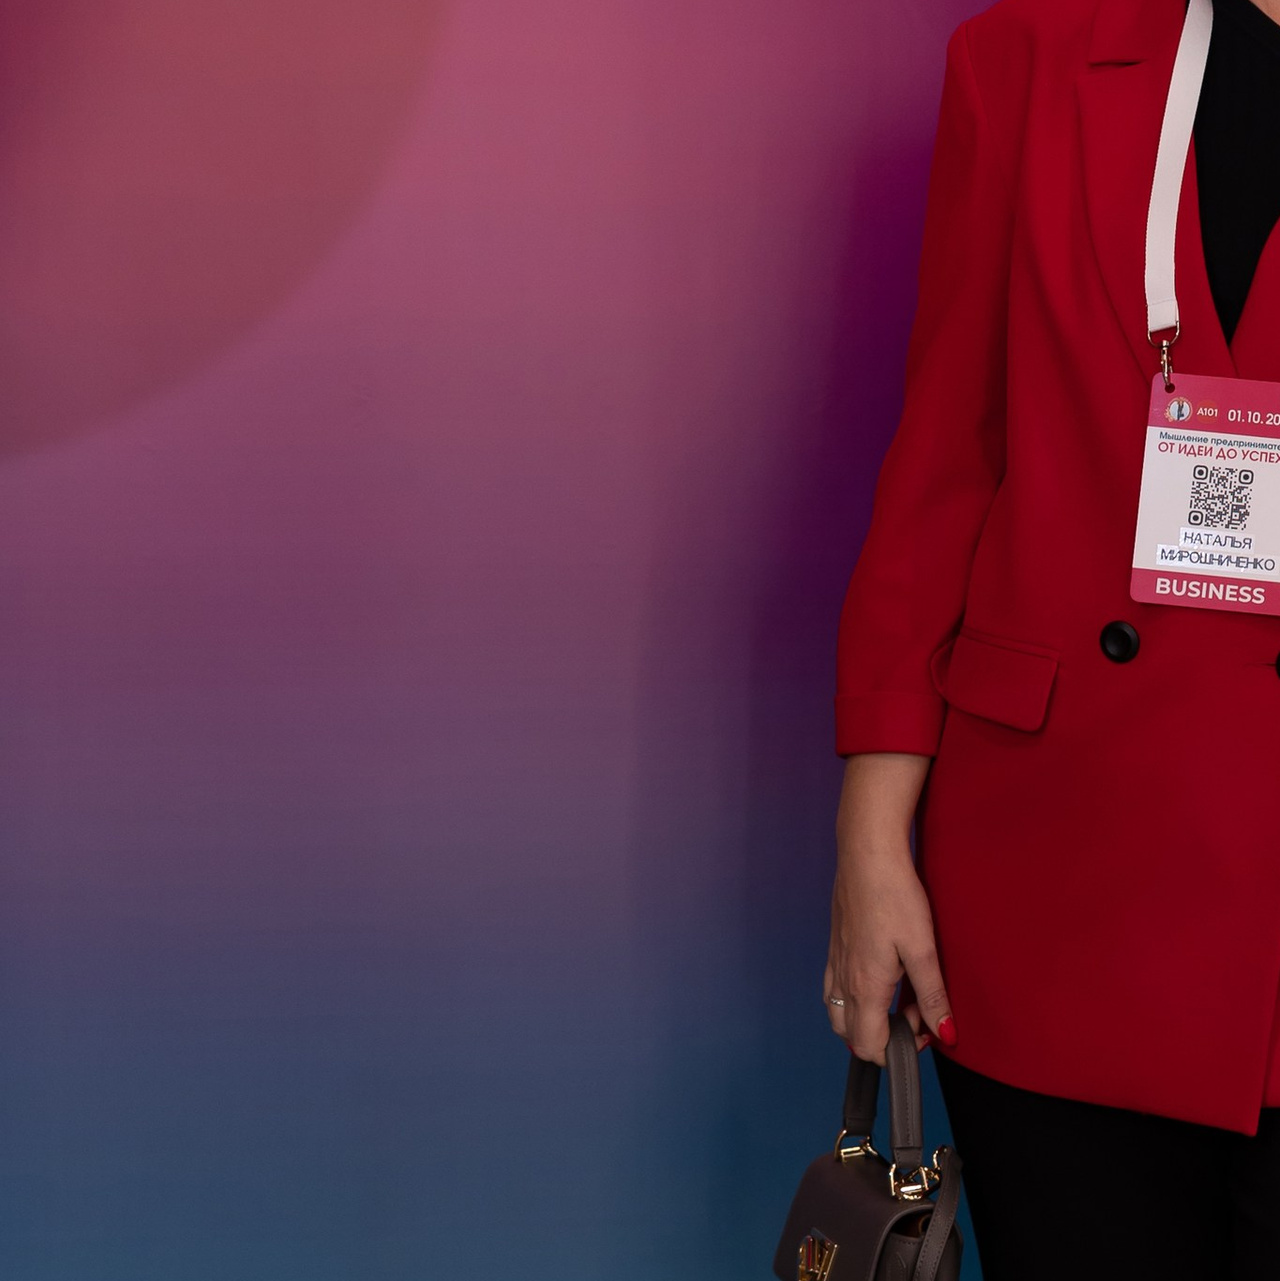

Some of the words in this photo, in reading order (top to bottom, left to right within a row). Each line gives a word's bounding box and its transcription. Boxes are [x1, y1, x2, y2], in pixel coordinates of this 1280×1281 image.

[1159, 431, 1209, 444] Мышление
[1158, 441, 1175, 453] ОТ
[1178, 443, 1213, 458] ИДЕИ
[1216, 447, 1237, 460] ДО
[1183, 531, 1252, 550] НАТАЛЬЯ
[1160, 548, 1276, 571] МИРОШНИЧЕНКО
[1155, 577, 1266, 604] BUSINESS
